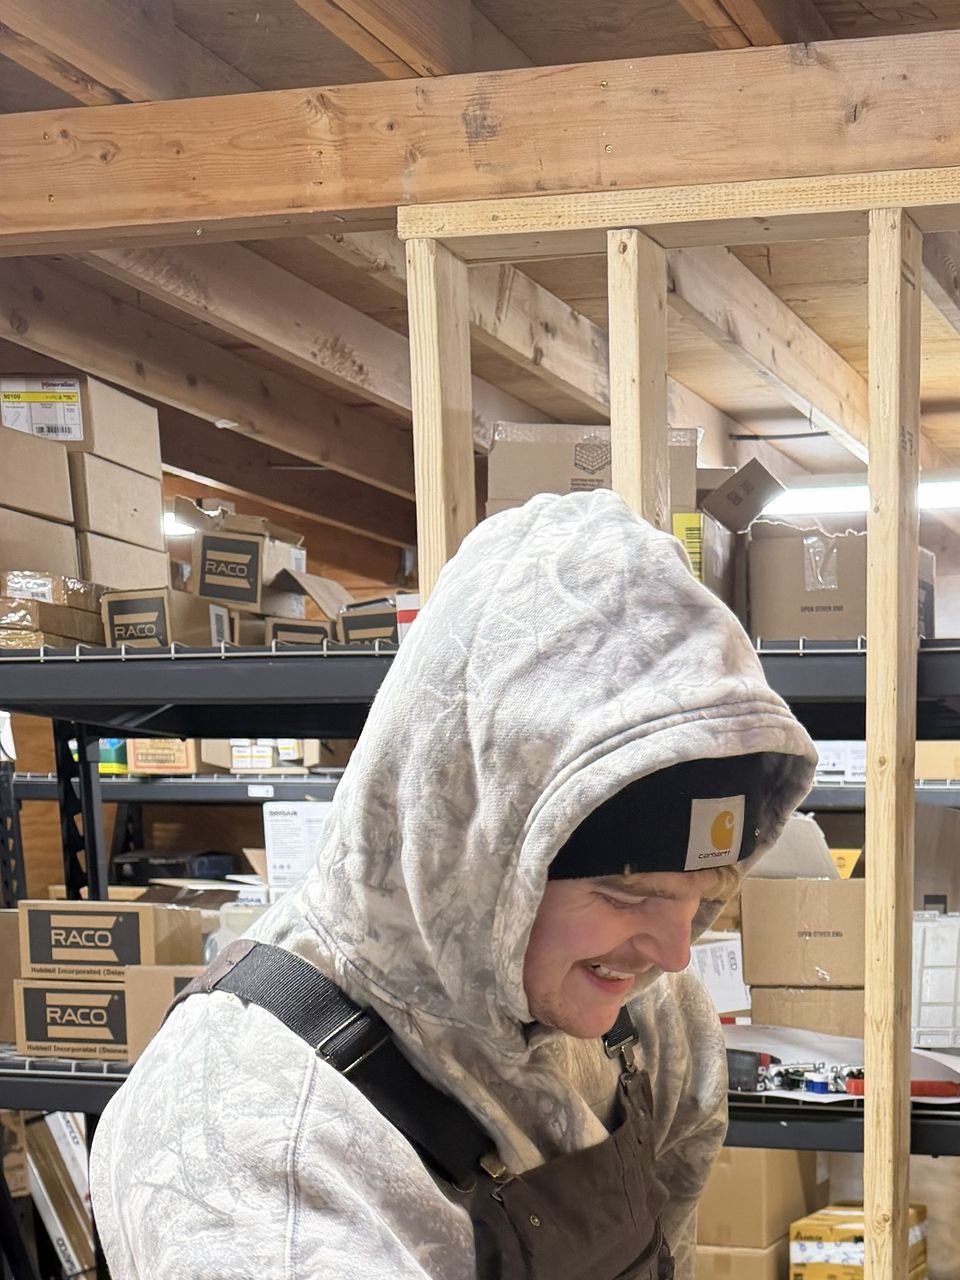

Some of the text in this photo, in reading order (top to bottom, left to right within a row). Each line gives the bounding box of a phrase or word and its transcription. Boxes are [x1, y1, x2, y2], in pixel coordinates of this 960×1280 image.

[204, 560, 248, 577] RACO
[114, 624, 156, 638] RACO
[51, 929, 113, 947] RACO
[46, 1007, 108, 1025] RACO
